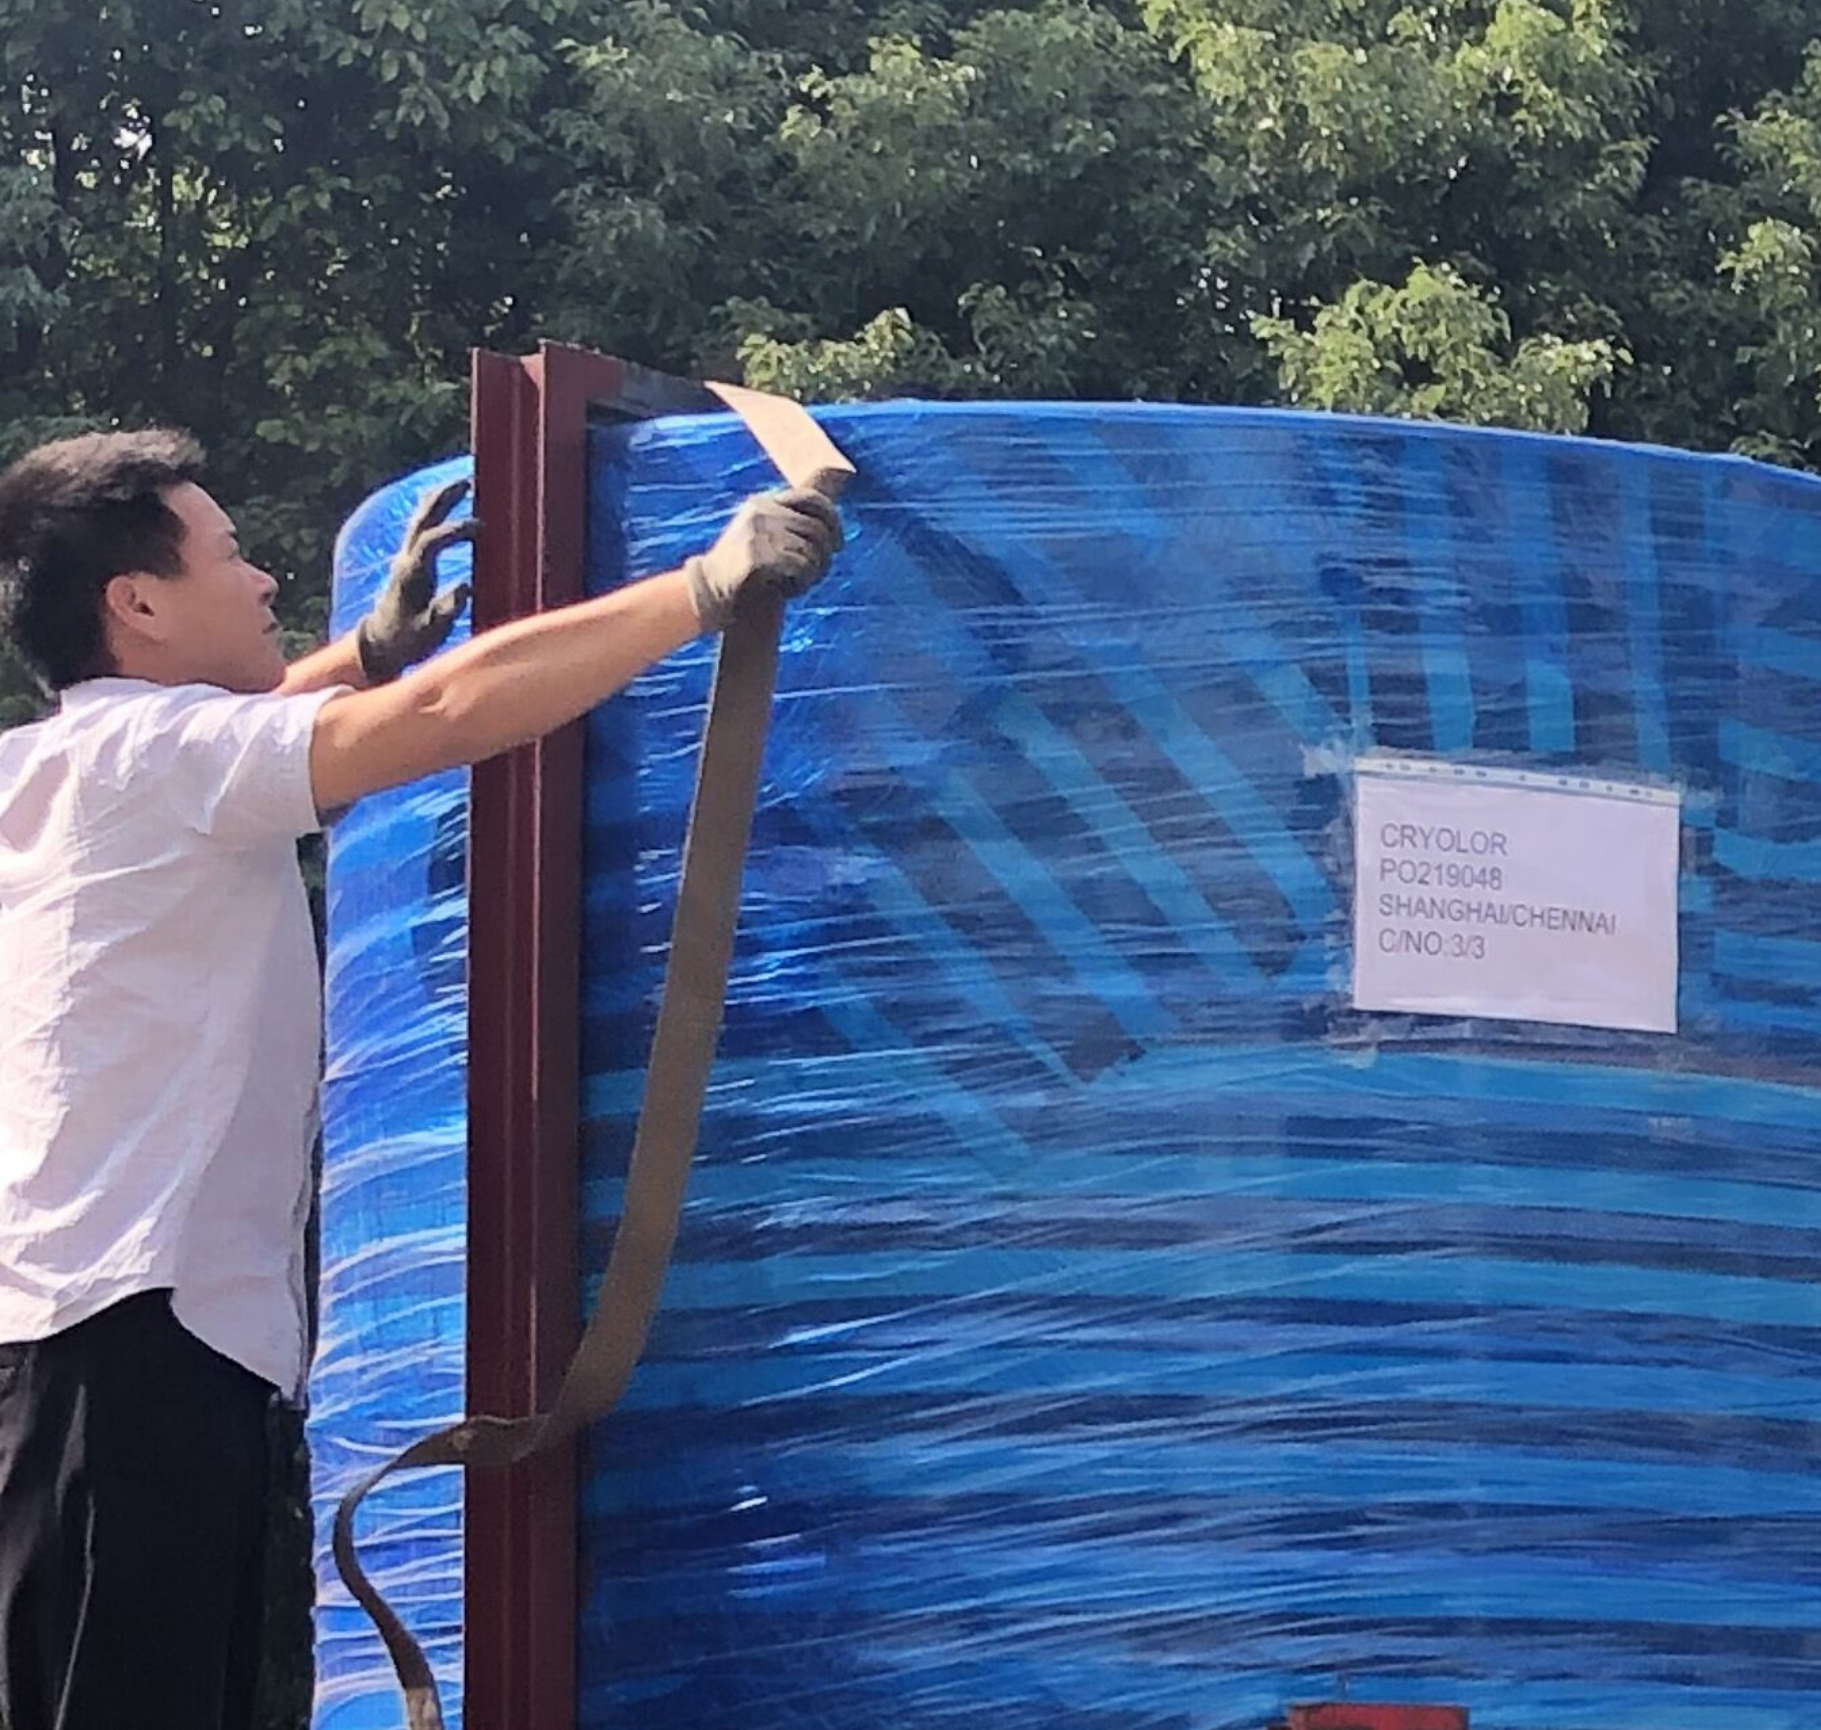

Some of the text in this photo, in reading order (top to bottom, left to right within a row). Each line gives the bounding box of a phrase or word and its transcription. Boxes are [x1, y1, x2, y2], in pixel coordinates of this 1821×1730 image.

[1380, 823, 1508, 856] CRYOLOR
[1379, 857, 1503, 891] PO219048
[1378, 893, 1617, 934] SHANGHAI/CHENNAI
[1378, 928, 1486, 960] C/NO:3/3
